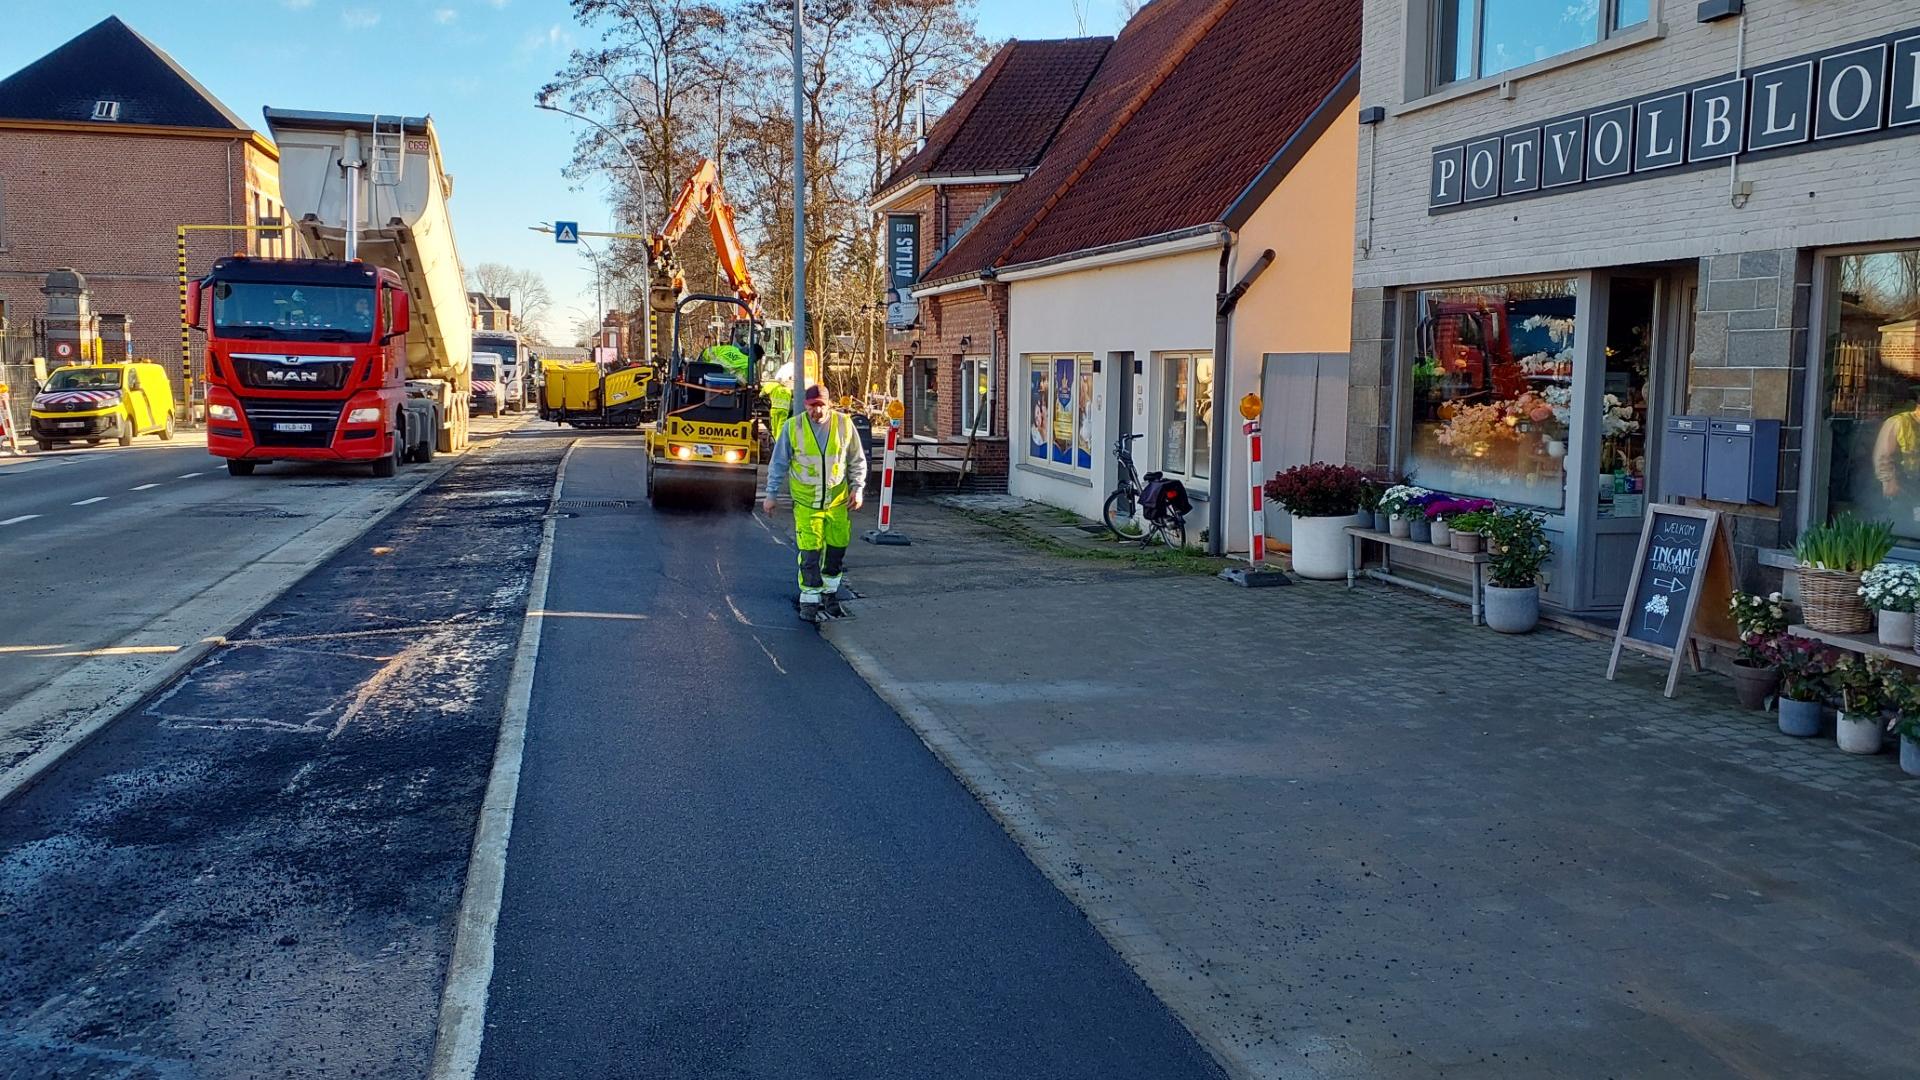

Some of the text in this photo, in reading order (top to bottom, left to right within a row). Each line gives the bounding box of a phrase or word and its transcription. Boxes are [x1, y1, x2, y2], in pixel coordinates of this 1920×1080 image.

[896, 224, 914, 232] RESTO
[896, 237, 914, 278] ATLAS
[266, 370, 317, 382] MAN
[698, 426, 739, 437] BOMAG
[1664, 521, 1696, 536] WELKOM
[1650, 546, 1699, 568] INGANG
